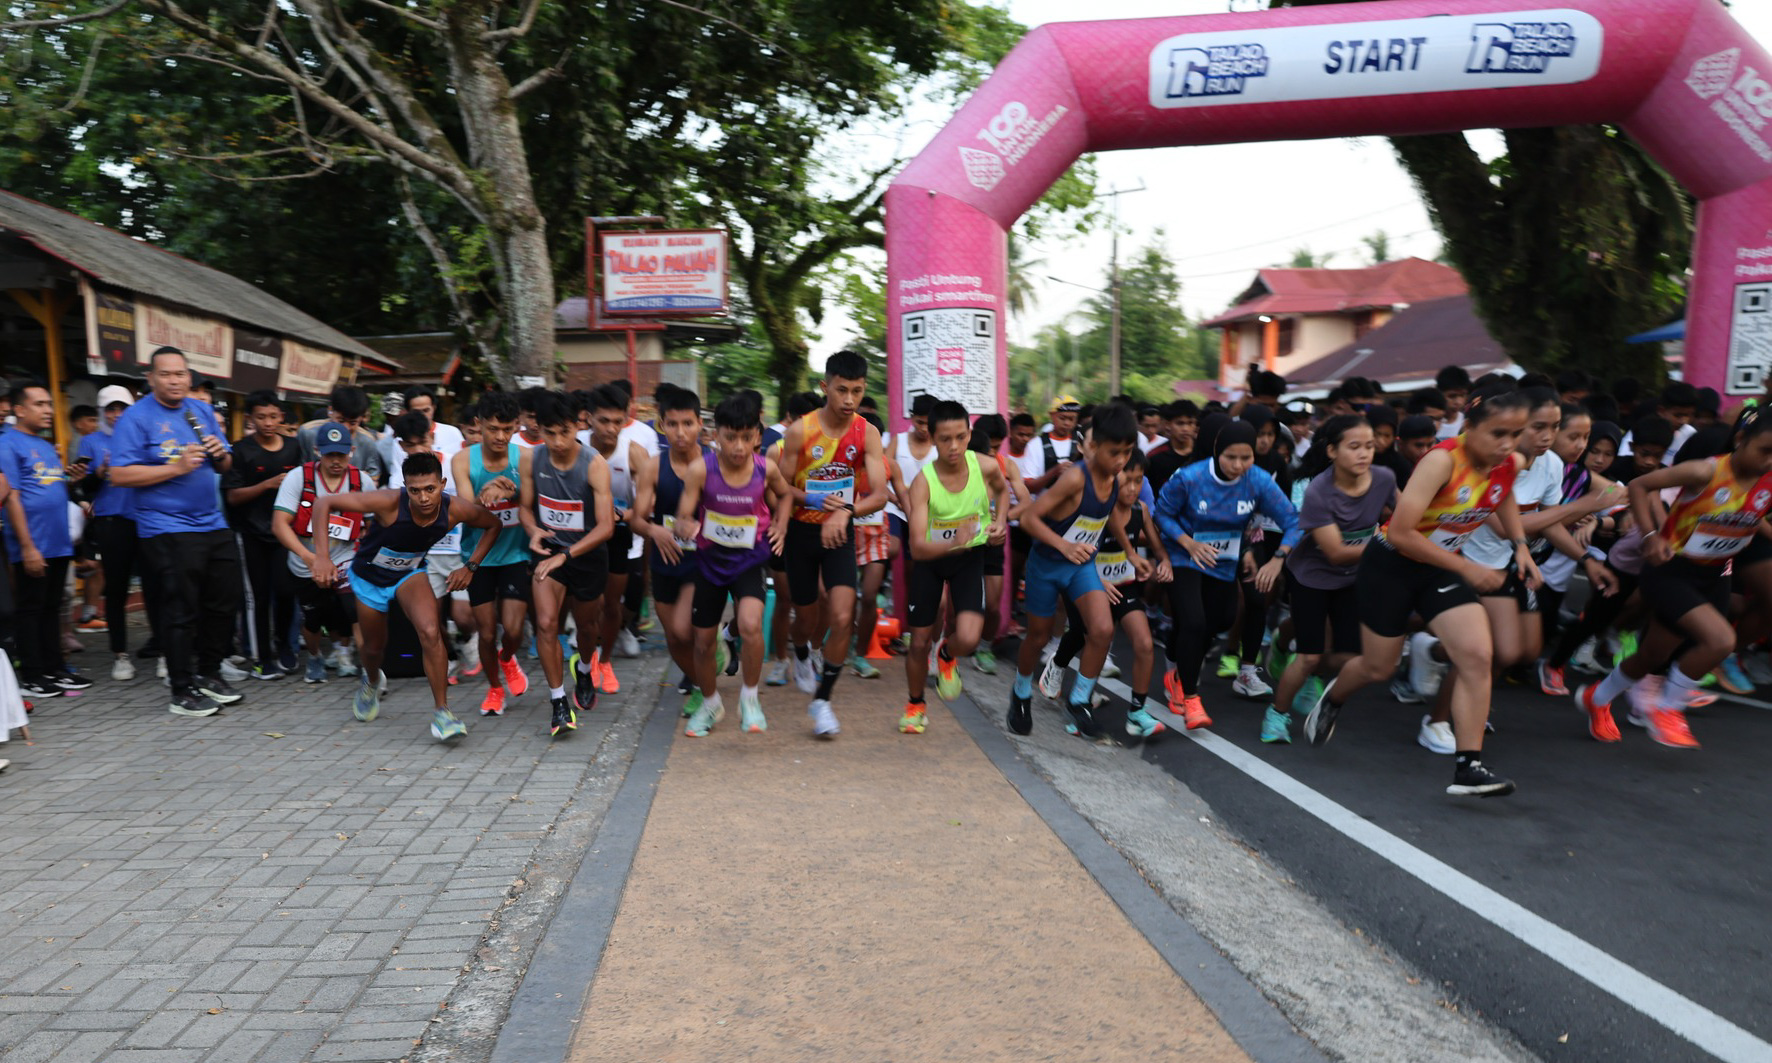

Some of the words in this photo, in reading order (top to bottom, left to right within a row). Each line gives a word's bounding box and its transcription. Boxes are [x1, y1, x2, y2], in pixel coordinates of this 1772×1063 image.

[1511, 22, 1571, 39] TALAO
[1207, 43, 1265, 61] TALAO
[1510, 36, 1575, 56] BEACH
[1323, 36, 1427, 75] START
[1506, 54, 1547, 72] RUN
[1207, 57, 1269, 77] BEACH
[1203, 76, 1244, 95] RUN
[1004, 103, 1069, 167] INDONESIA
[547, 509, 574, 524] 307
[385, 557, 412, 567] 204
[1102, 560, 1128, 577] 056
